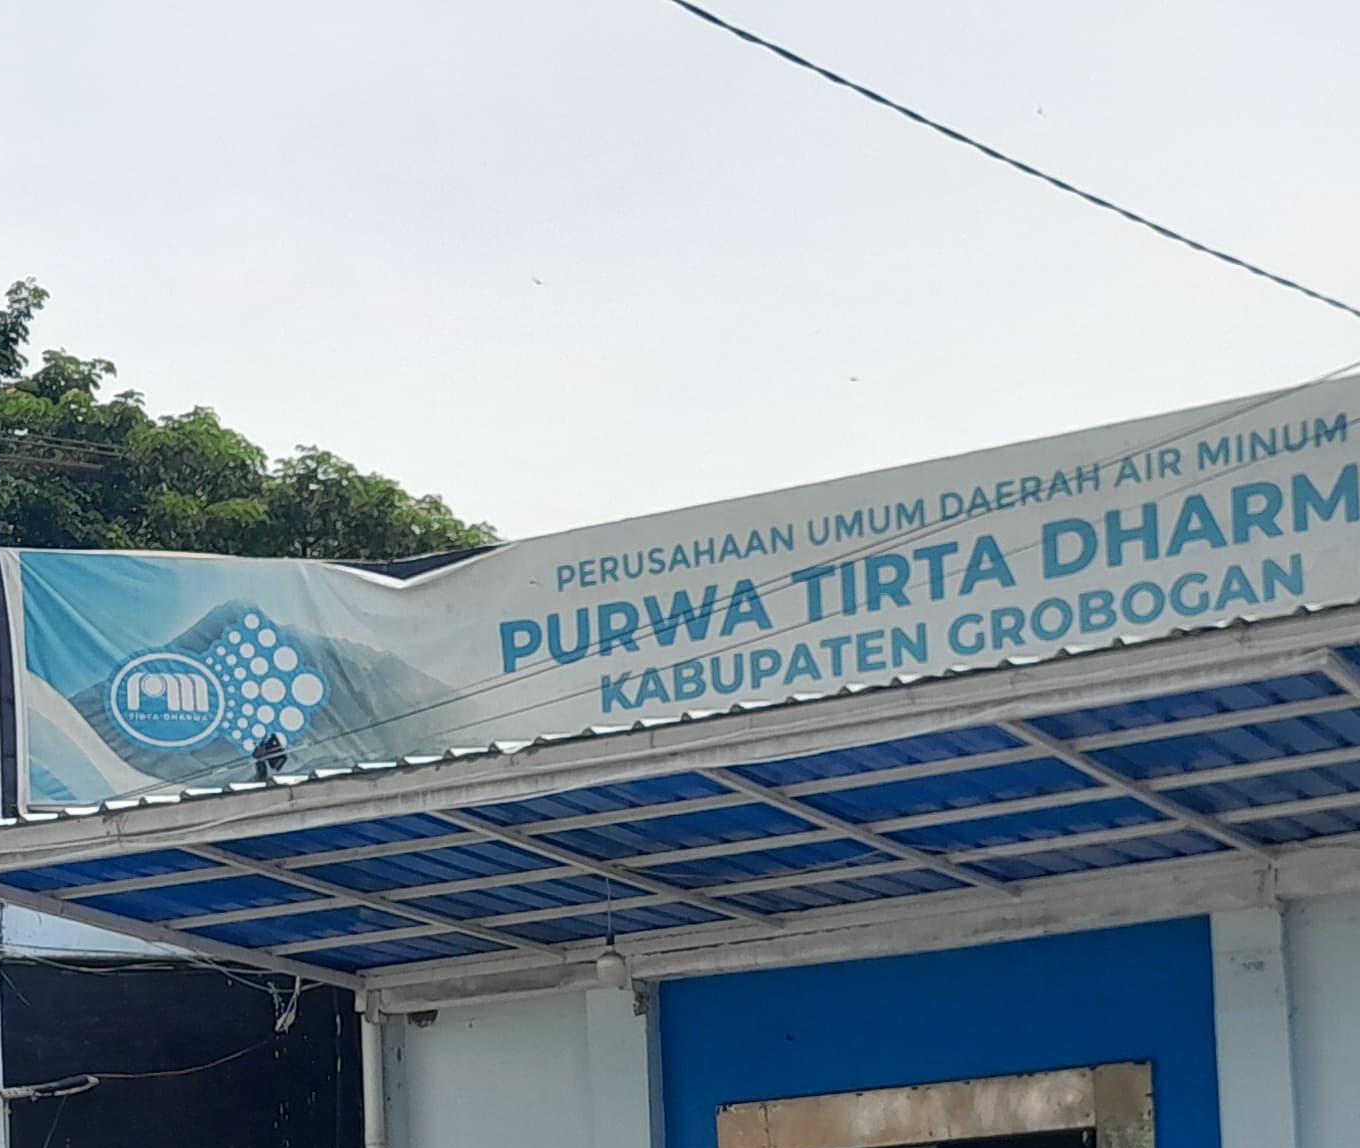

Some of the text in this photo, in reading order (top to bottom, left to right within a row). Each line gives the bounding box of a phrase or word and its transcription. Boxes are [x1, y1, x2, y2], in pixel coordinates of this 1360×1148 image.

[556, 413, 1348, 593] PERUSAHAAN UMUM DAERAH AIR MINUM
[499, 578, 773, 673] PURWA
[790, 534, 1017, 623] TIRTA
[601, 552, 1305, 713] KABUPATEN GROBOGAN
